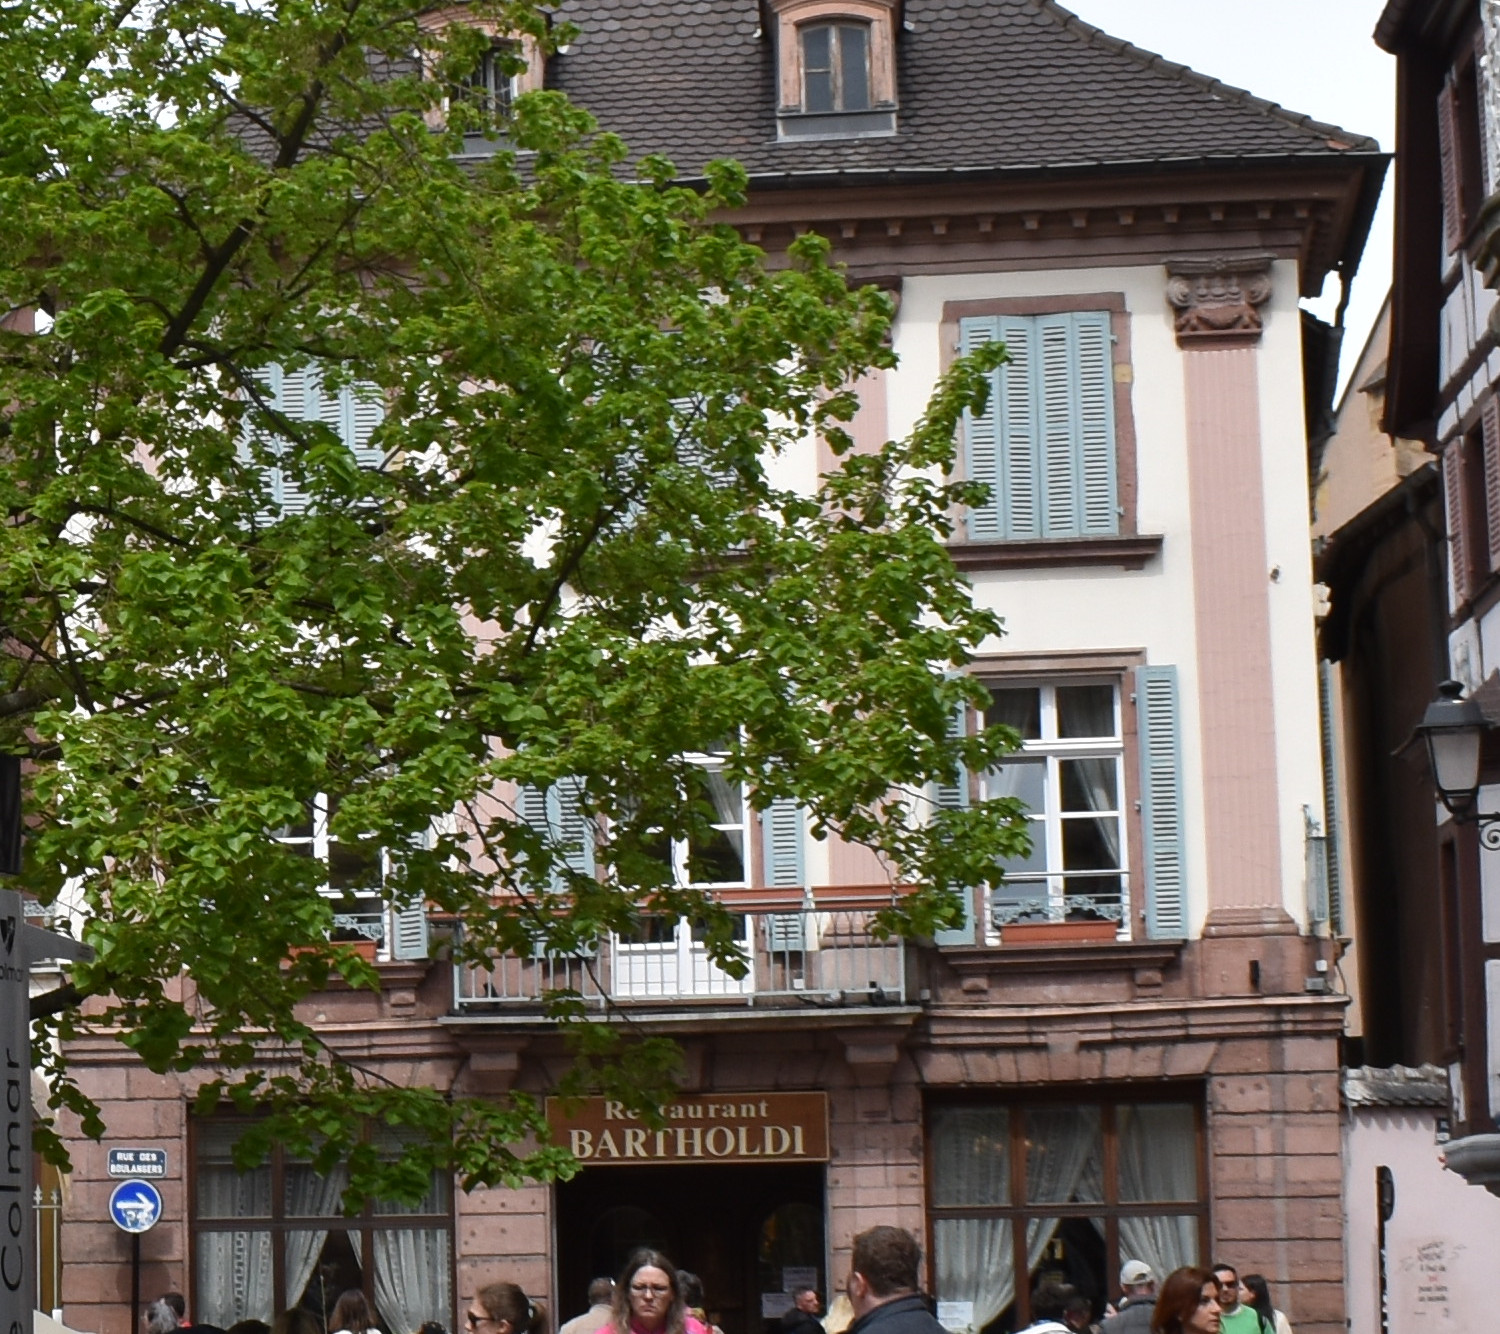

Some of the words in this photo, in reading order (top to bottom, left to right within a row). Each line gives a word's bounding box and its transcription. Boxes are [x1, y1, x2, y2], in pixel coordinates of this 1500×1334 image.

[605, 1099, 769, 1120] Reaurant
[569, 1125, 806, 1159] BARTHOLDI
[116, 1152, 134, 1161] RUE
